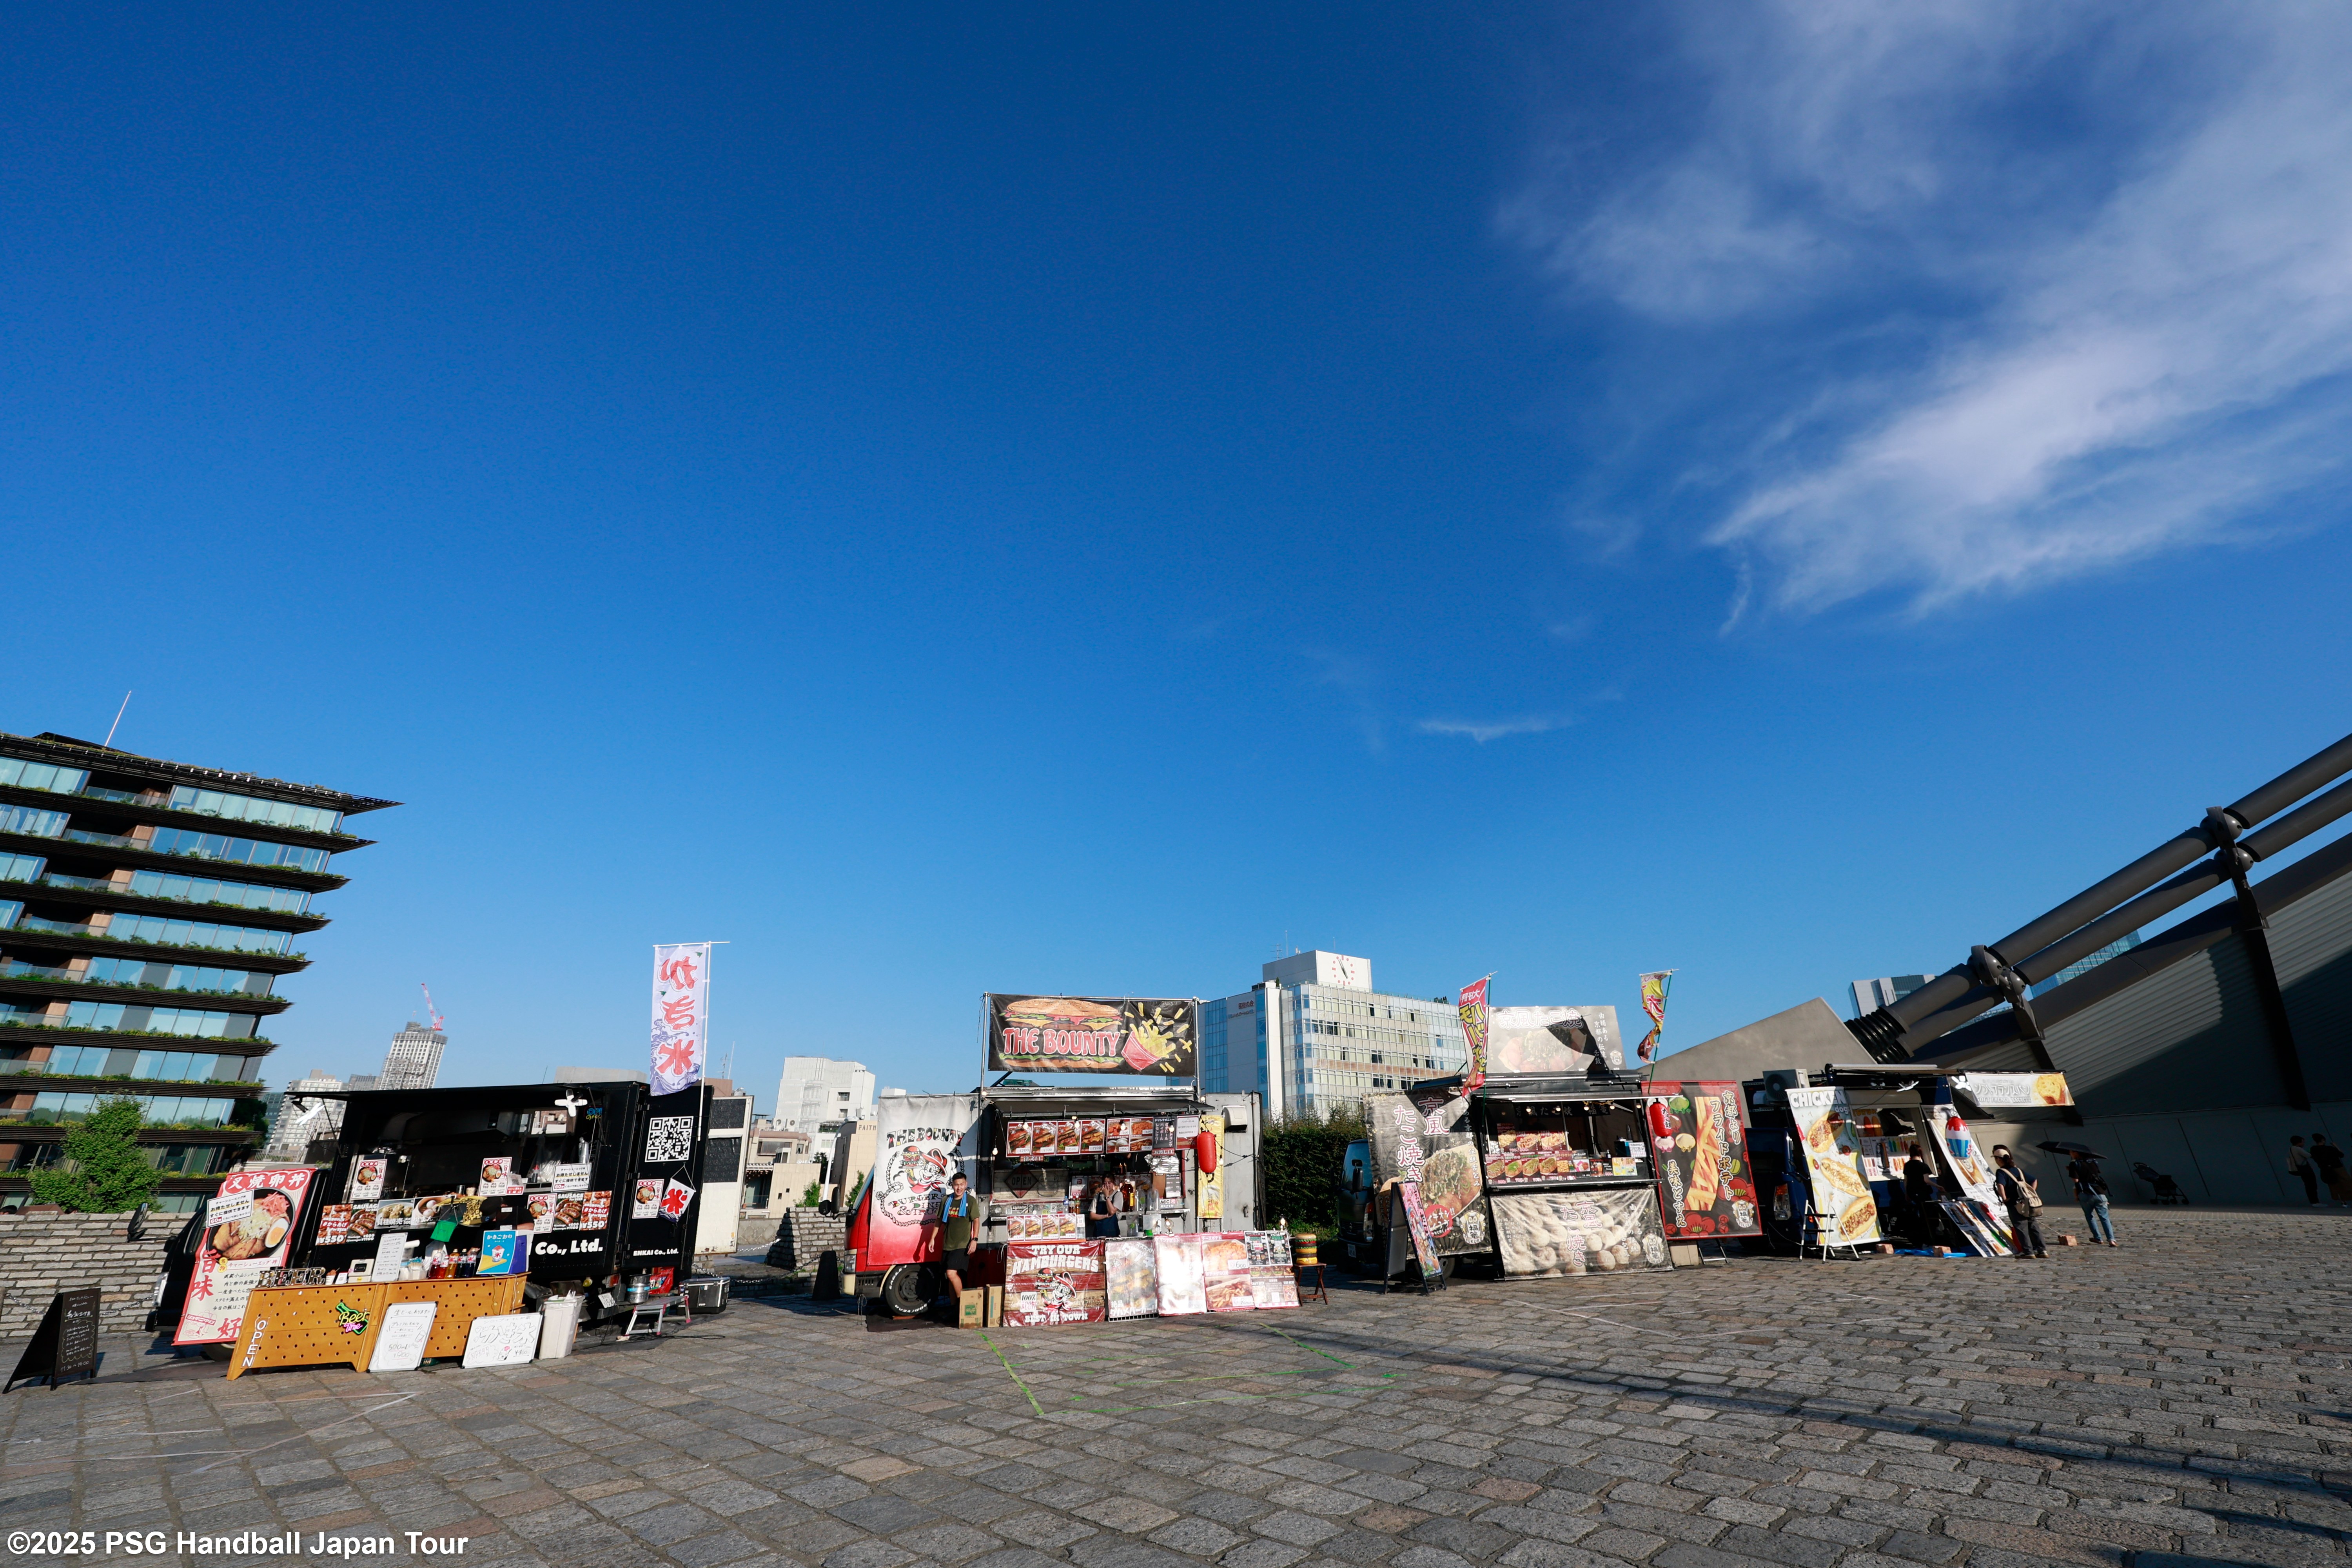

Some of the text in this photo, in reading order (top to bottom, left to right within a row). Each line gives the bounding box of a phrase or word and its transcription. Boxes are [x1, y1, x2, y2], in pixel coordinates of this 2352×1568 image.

[1496, 1008, 1583, 1030] 京風たこ焼
[1004, 1028, 1120, 1056] THE BOUNTY
[1790, 1092, 1847, 1108] CHICKEN
[1417, 1097, 1449, 1135] 京風
[1722, 1090, 1741, 1145] 京都より
[886, 1127, 965, 1149] THE BOUNTY
[1393, 1105, 1426, 1182] たこ焼き
[1710, 1100, 1734, 1201] フライドポテト
[228, 1172, 305, 1190] 叉焼卵丼
[1012, 1177, 1032, 1185] OPEN
[660, 1188, 688, 1215] 氷
[1667, 1159, 1687, 1228] 美味どすえ
[210, 1205, 250, 1218] すぐに提供できます
[211, 1200, 250, 1212] お待たせしません
[1575, 1200, 1602, 1229] 京風
[535, 1241, 567, 1255] Co.,
[570, 1238, 603, 1253] Ltd.
[1560, 1205, 1587, 1267] たこ焼き
[1032, 1244, 1080, 1255] TRY OUR
[1137, 1242, 1153, 1254] オススメ!
[191, 1249, 221, 1301] 旨味
[1011, 1255, 1099, 1276] HAMBURGERS
[256, 1267, 327, 1288] BEER
[217, 1317, 242, 1339] 好
[339, 1311, 370, 1326] Beer
[1025, 1314, 1046, 1323] BEST
[1063, 1312, 1088, 1321] TOWN
[241, 1319, 267, 1367] OPEN
[479, 1322, 537, 1345] かき氷
